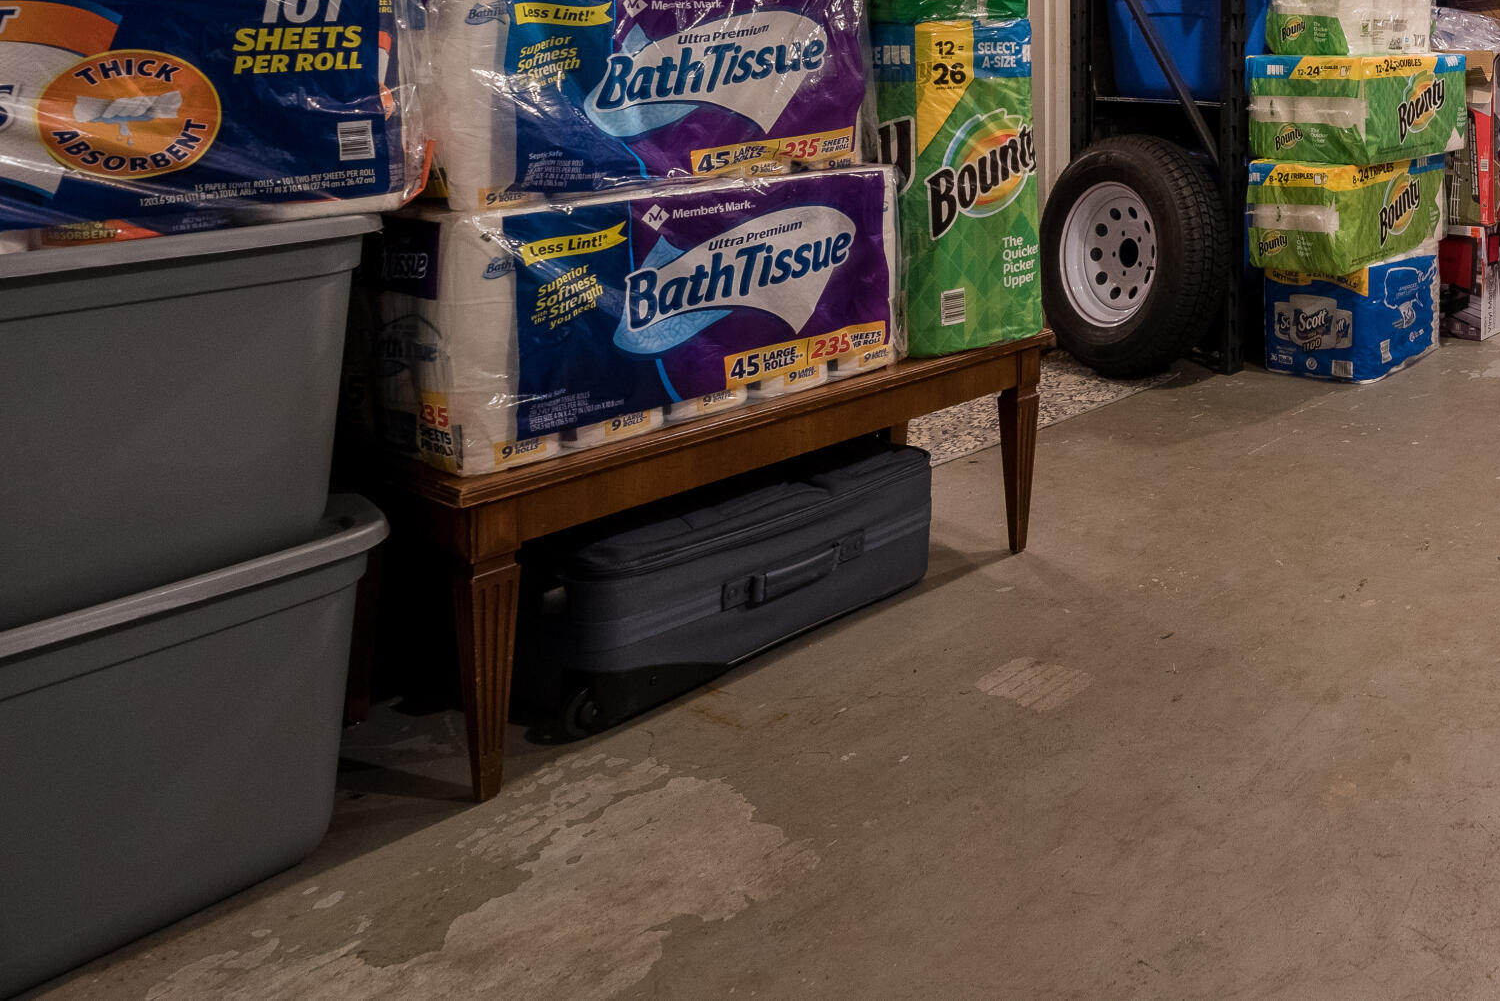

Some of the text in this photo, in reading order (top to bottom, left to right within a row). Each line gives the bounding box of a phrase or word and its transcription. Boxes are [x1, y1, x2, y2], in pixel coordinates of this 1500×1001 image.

[522, 5, 550, 19] Less
[693, 0, 723, 10] Mark
[232, 25, 363, 52] SHEETS
[677, 24, 770, 46] Ultra Premium
[519, 36, 573, 58] Superior
[977, 41, 1019, 55] SELECT-
[233, 52, 364, 75] PER ROLL
[517, 47, 579, 73] Softness
[981, 55, 1017, 69] A-SIZE
[74, 58, 181, 86] THICK
[932, 62, 967, 86] 26
[1398, 78, 1446, 144] Bounty
[53, 117, 209, 173] ABSORBENT
[779, 137, 821, 159] 235
[822, 135, 850, 147] SHEETS
[697, 150, 730, 174] 45
[204, 168, 375, 192] PAPER ROLLS SHEETS PER ROLL
[672, 200, 751, 219] Member's Mark
[1379, 179, 1421, 249] Bounty
[708, 221, 803, 251] Ultra Premium
[1002, 235, 1024, 249] The
[1258, 234, 1288, 257] Bounty
[529, 242, 564, 258] Less
[1002, 242, 1039, 261] Quicker
[1002, 259, 1035, 275] Picker
[537, 263, 590, 297] Superior
[1003, 272, 1036, 289] Upper
[535, 274, 598, 312] Softness
[549, 283, 604, 319] Strength
[549, 300, 597, 330] you need
[1298, 308, 1327, 332] Scott
[762, 346, 797, 363] LARGE
[810, 332, 850, 360] 235
[729, 353, 761, 380] 45
[789, 371, 797, 382] 9
[612, 419, 621, 431] 9
[501, 445, 513, 459] 9
